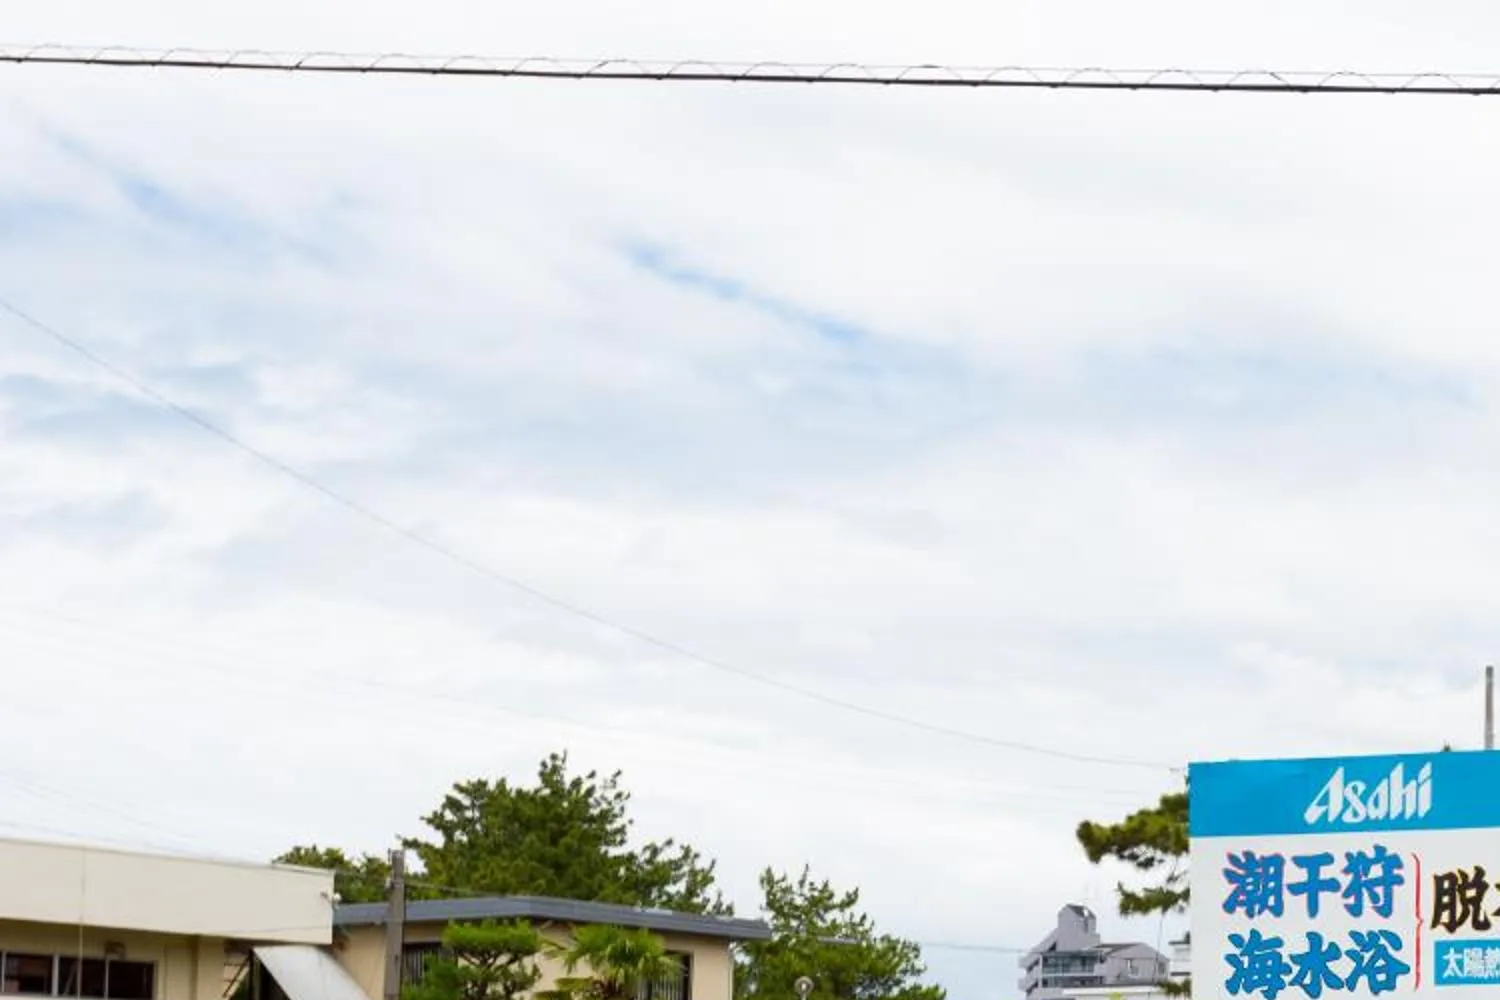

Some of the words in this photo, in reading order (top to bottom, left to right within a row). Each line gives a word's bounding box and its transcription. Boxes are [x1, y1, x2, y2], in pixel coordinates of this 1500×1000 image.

[1304, 762, 1432, 824] Asahi
[1222, 844, 1405, 919] 潮干狩
